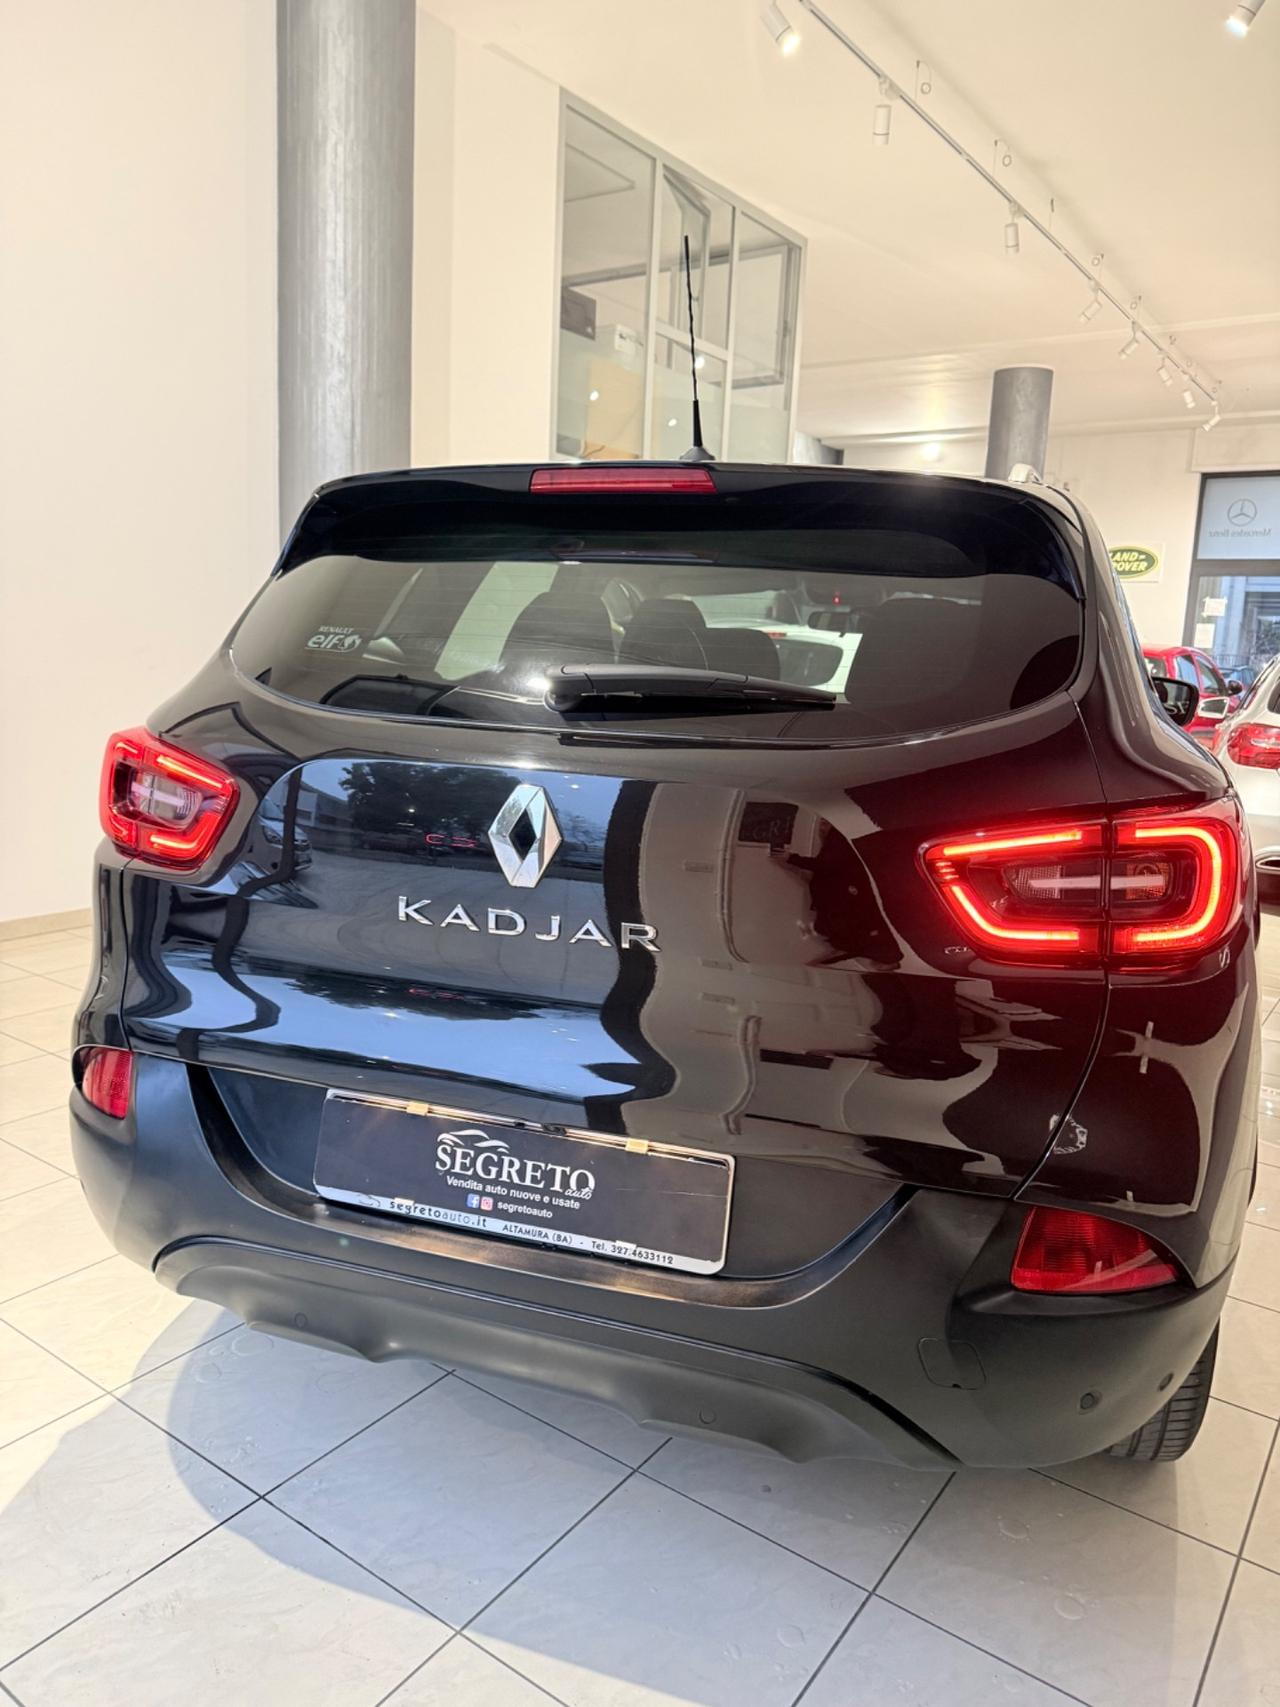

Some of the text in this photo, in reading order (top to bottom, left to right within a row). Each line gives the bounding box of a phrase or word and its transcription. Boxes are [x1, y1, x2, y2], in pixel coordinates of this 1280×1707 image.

[307, 634, 345, 649] elf
[398, 895, 661, 952] KADJAR
[435, 1144, 596, 1193] SEGRETO
[446, 1175, 581, 1210] Vendita auto nuove e usate
[565, 1186, 593, 1200] auto
[390, 1200, 487, 1228] segretoauto.it
[497, 1201, 553, 1219] segretoauto
[502, 1223, 550, 1241] ALTAMURA
[552, 1230, 573, 1245] (BA)
[591, 1241, 608, 1251] Tel.
